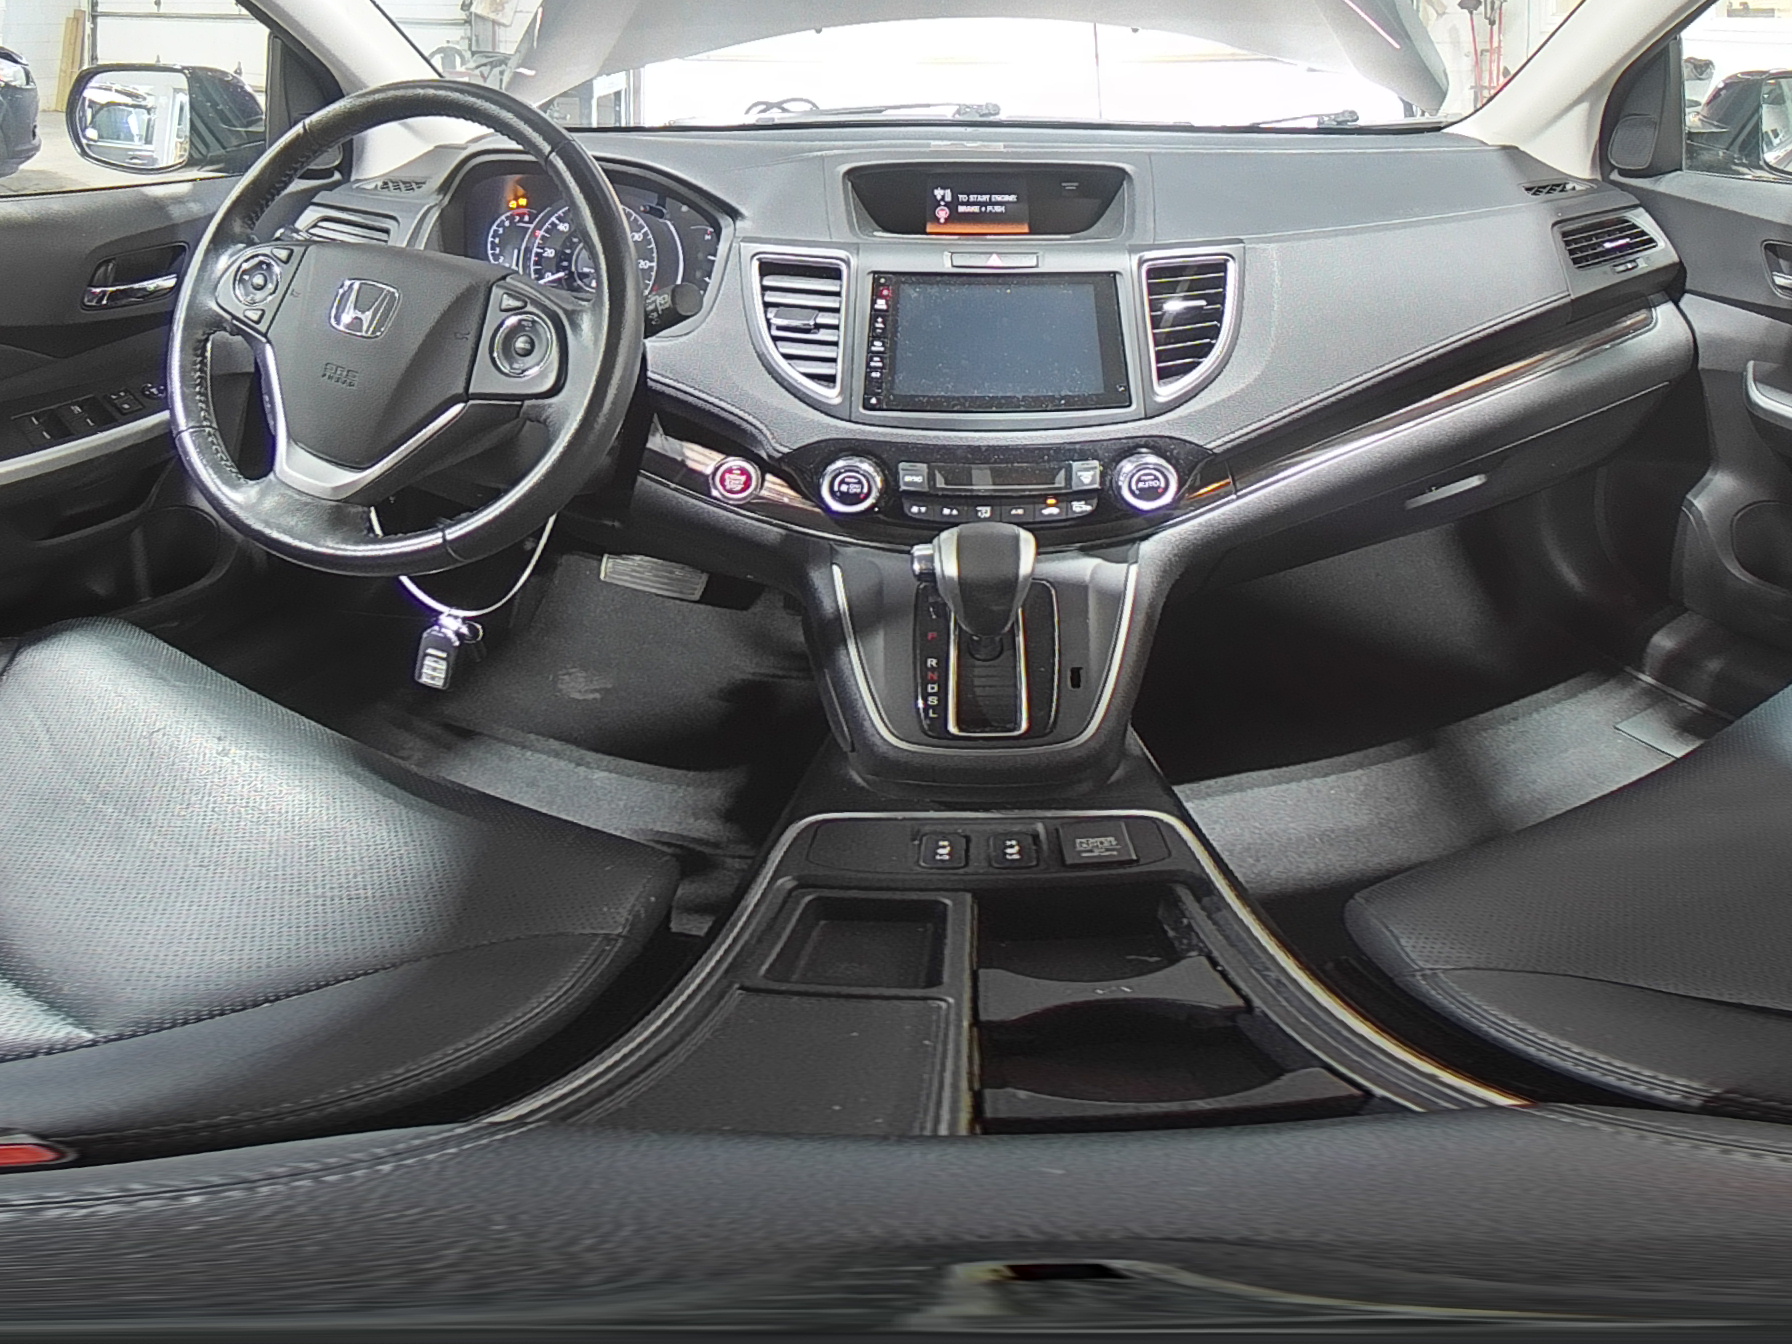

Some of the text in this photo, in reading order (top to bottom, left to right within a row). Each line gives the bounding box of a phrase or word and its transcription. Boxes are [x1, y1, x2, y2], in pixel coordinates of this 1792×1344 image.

[957, 194, 968, 202] TO
[969, 194, 990, 202] START
[557, 223, 570, 232] 40
[542, 248, 555, 257] 20
[927, 658, 938, 668] R
[928, 672, 938, 680] N
[927, 683, 939, 693] D
[927, 695, 939, 705] S
[929, 708, 938, 718] L
